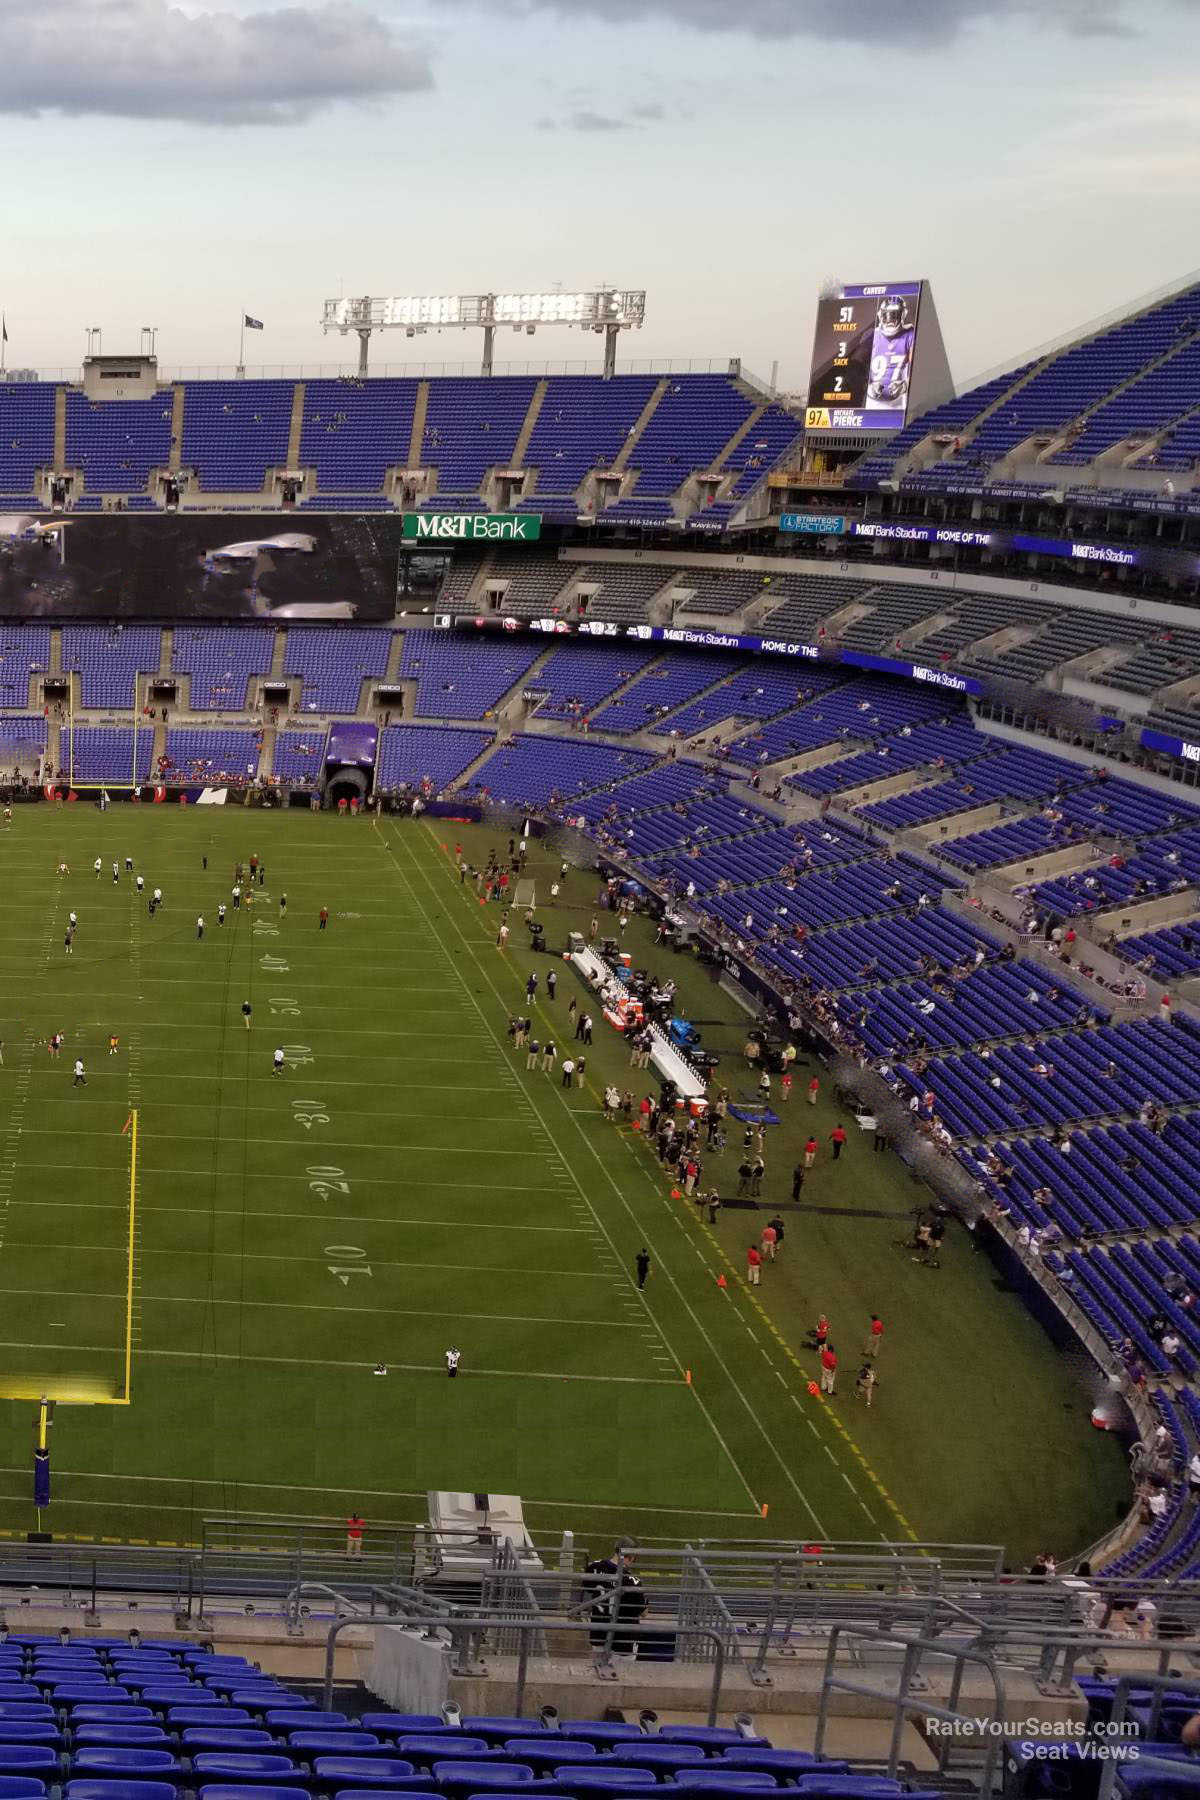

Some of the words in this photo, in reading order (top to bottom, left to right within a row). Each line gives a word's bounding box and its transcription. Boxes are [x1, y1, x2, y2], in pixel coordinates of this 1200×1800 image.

[840, 307, 853, 322] 51
[833, 323, 857, 331] TACKLES
[838, 342, 846, 357] 3
[834, 358, 848, 366] SACK
[871, 355, 906, 381] 97
[834, 376, 842, 392] 2
[809, 410, 822, 425] 97
[833, 416, 863, 427] PIERCE
[416, 515, 472, 537] M&T
[473, 516, 526, 539] Bank
[796, 524, 839, 532] FACTORY
[856, 524, 876, 535] M&T
[875, 525, 895, 537] Bank
[895, 526, 928, 540] Stadium
[936, 530, 961, 541] HOME
[961, 533, 974, 543] OF
[1072, 544, 1089, 559] M&T
[1089, 546, 1109, 561] Bank
[1107, 547, 1133, 563] Stadium
[663, 629, 687, 641] M&T
[686, 631, 705, 643] Bank
[705, 633, 739, 647] Stadium
[762, 640, 786, 652] HOME
[787, 643, 800, 654] OF
[800, 645, 818, 657] THE
[913, 665, 928, 680] M&T
[927, 668, 944, 684] Bank
[942, 671, 966, 690] Stadium
[1182, 742, 1200, 761] M&T
[252, 922, 280, 936] 30
[259, 956, 290, 973] 40
[268, 998, 301, 1016] 50
[291, 1100, 330, 1124] 30
[306, 1166, 350, 1194] 20
[324, 1245, 373, 1277] 10
